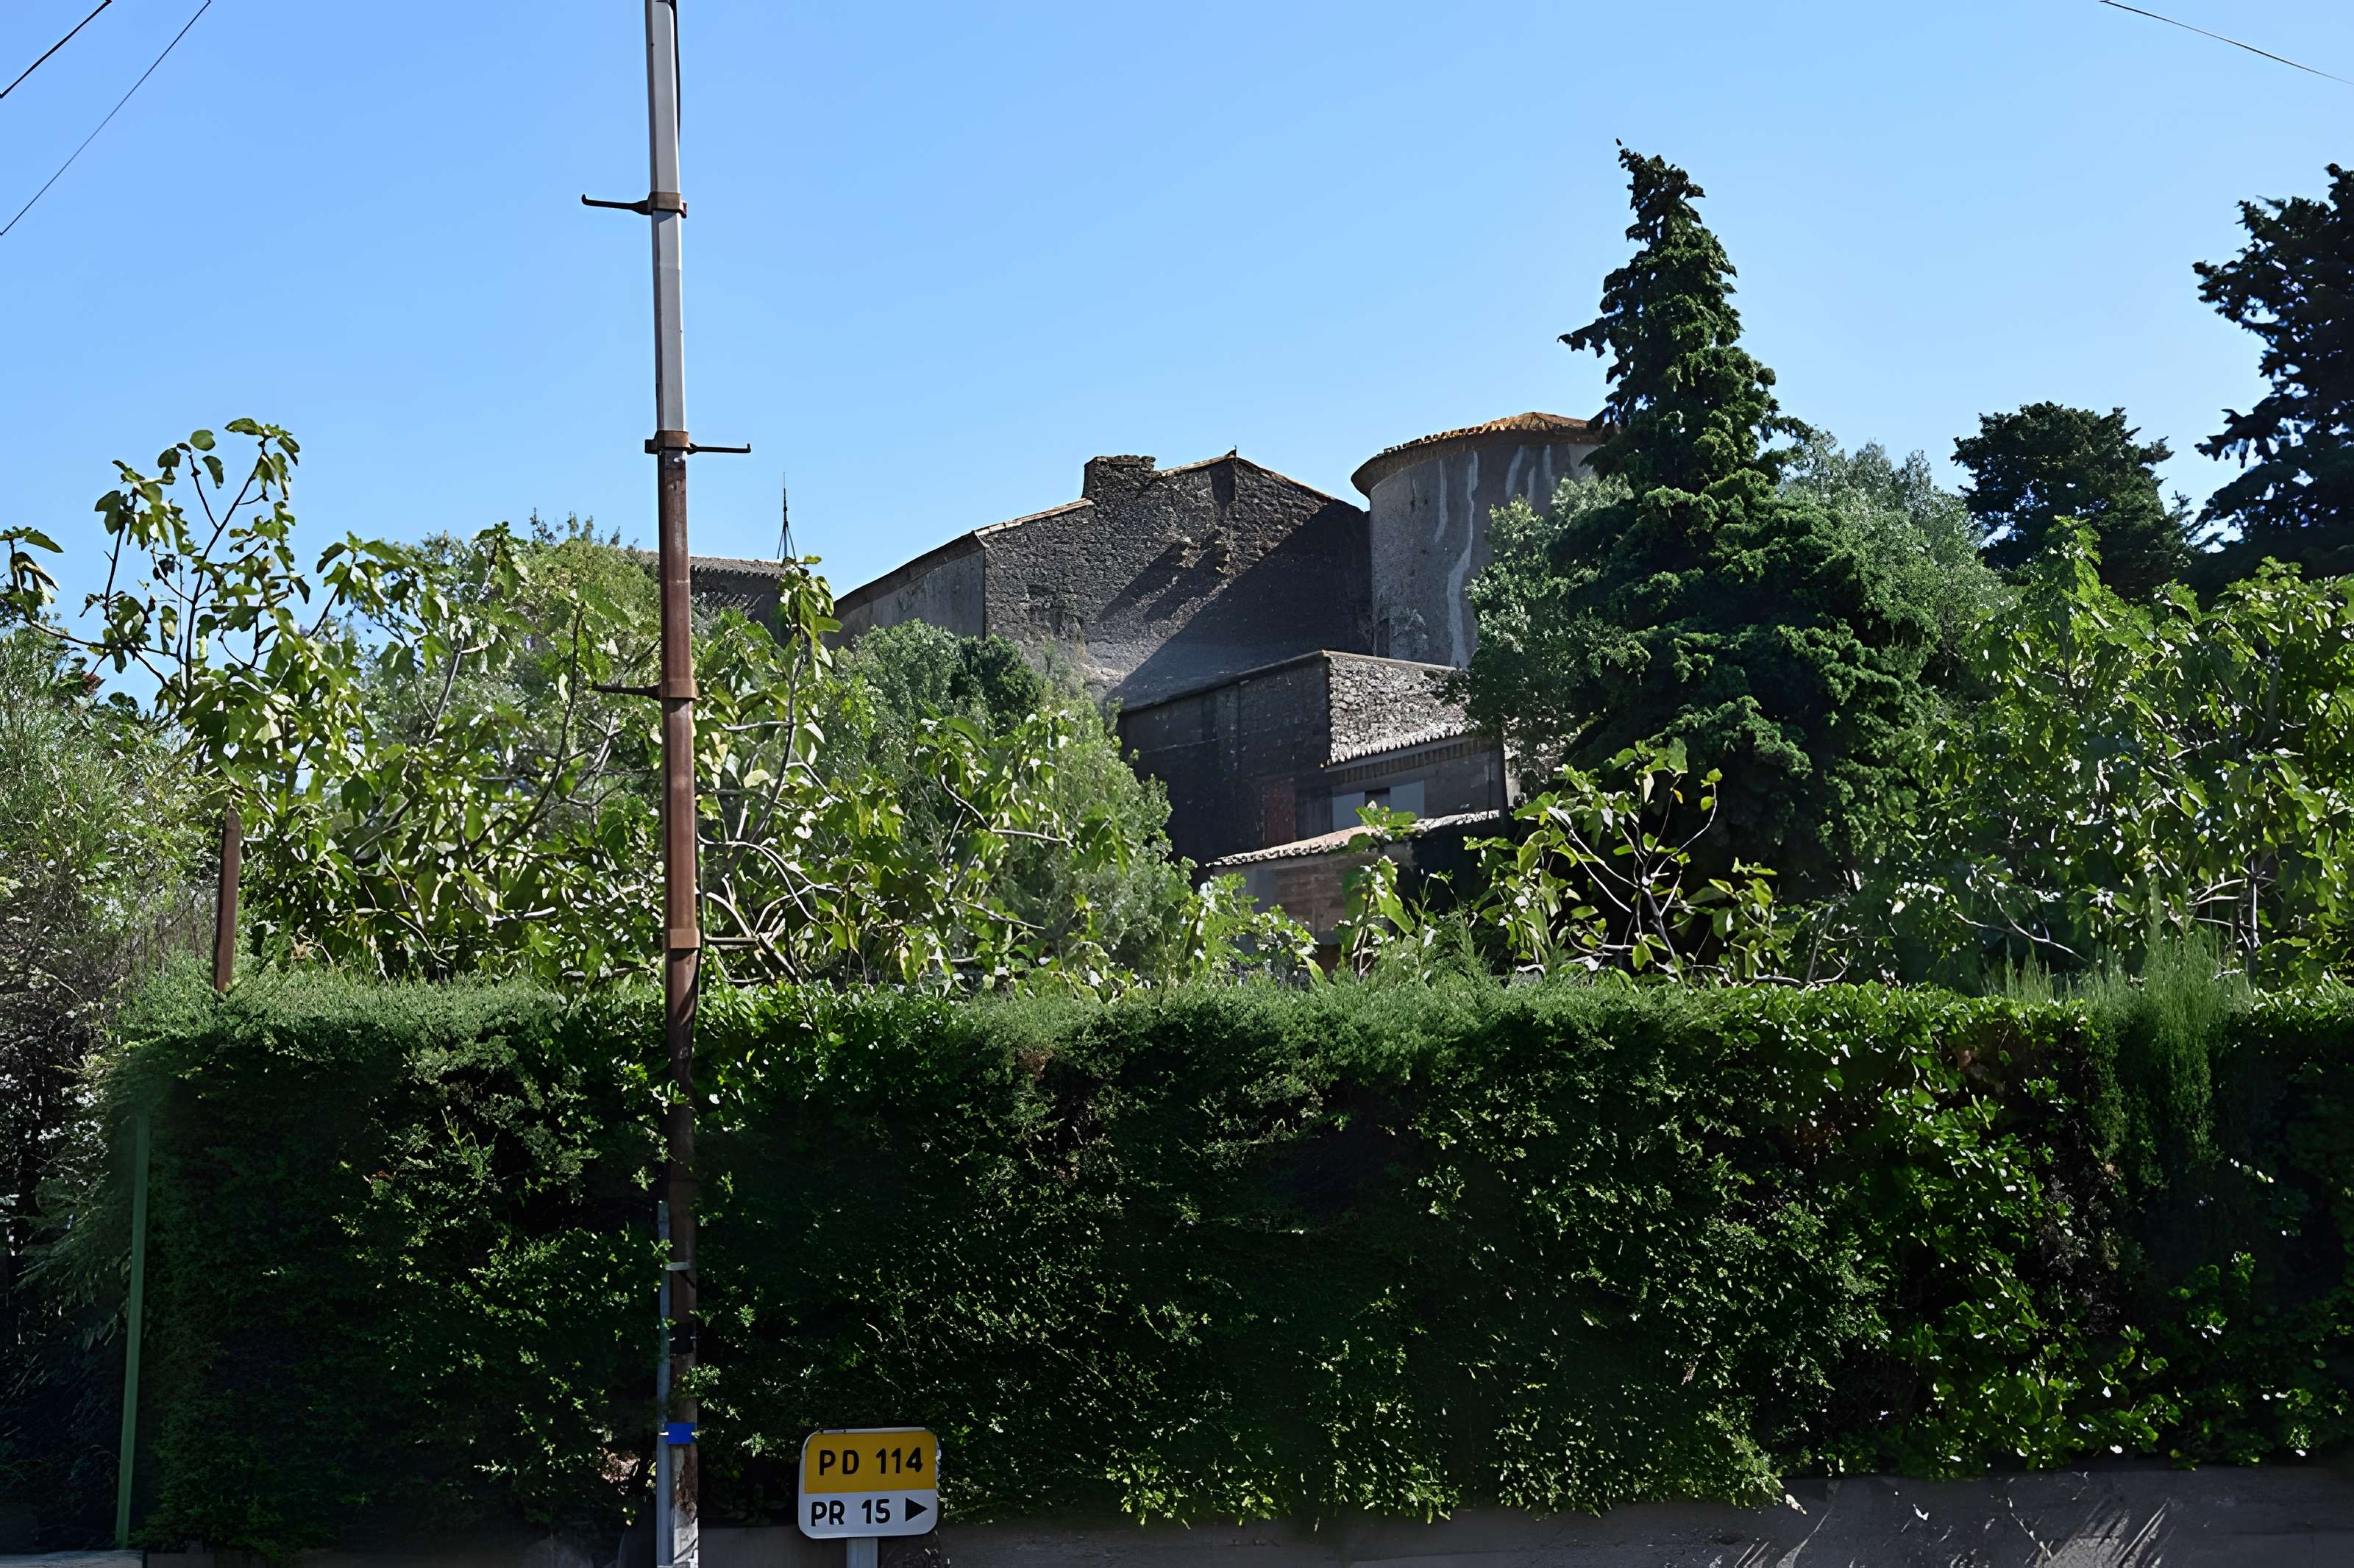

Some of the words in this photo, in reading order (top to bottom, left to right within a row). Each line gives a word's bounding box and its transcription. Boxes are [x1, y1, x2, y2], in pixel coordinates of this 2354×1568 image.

[819, 1450, 859, 1475] PD
[875, 1447, 922, 1474] 114
[811, 1500, 845, 1527] PR
[861, 1499, 891, 1524] 15
